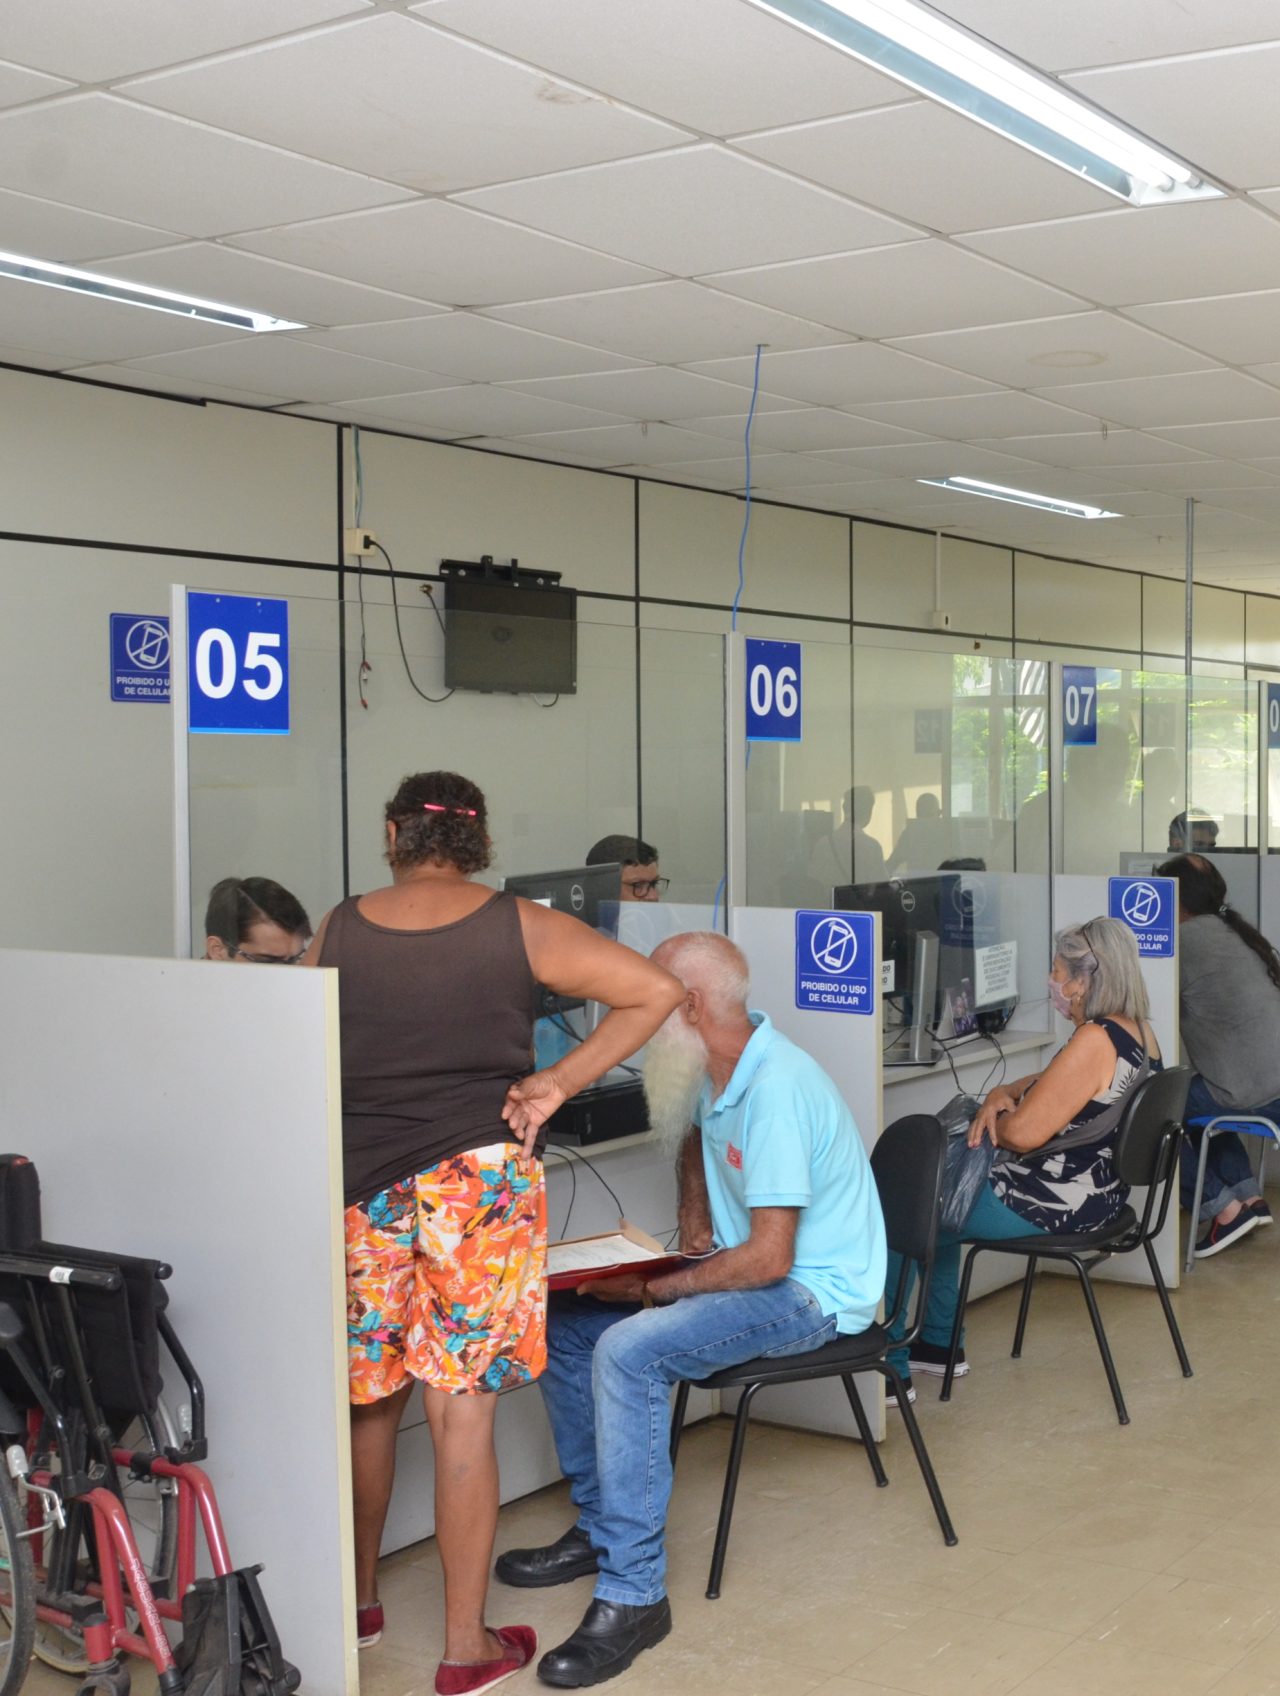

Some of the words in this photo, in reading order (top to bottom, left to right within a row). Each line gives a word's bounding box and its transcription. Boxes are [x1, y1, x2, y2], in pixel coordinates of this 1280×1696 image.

[196, 628, 283, 700] 05
[116, 676, 155, 686] PROIBIDO
[156, 678, 163, 686] O
[124, 687, 136, 695] DE
[137, 687, 170, 696] CELULA
[750, 664, 798, 717] 06
[1065, 685, 1094, 726] 07
[1153, 934, 1169, 942] USO
[1139, 942, 1162, 951] LULAR
[801, 981, 839, 992] PROIBIDO
[840, 984, 848, 993] O
[849, 985, 867, 995] USO
[808, 993, 820, 1002] DE
[821, 994, 859, 1005] CELULAR
